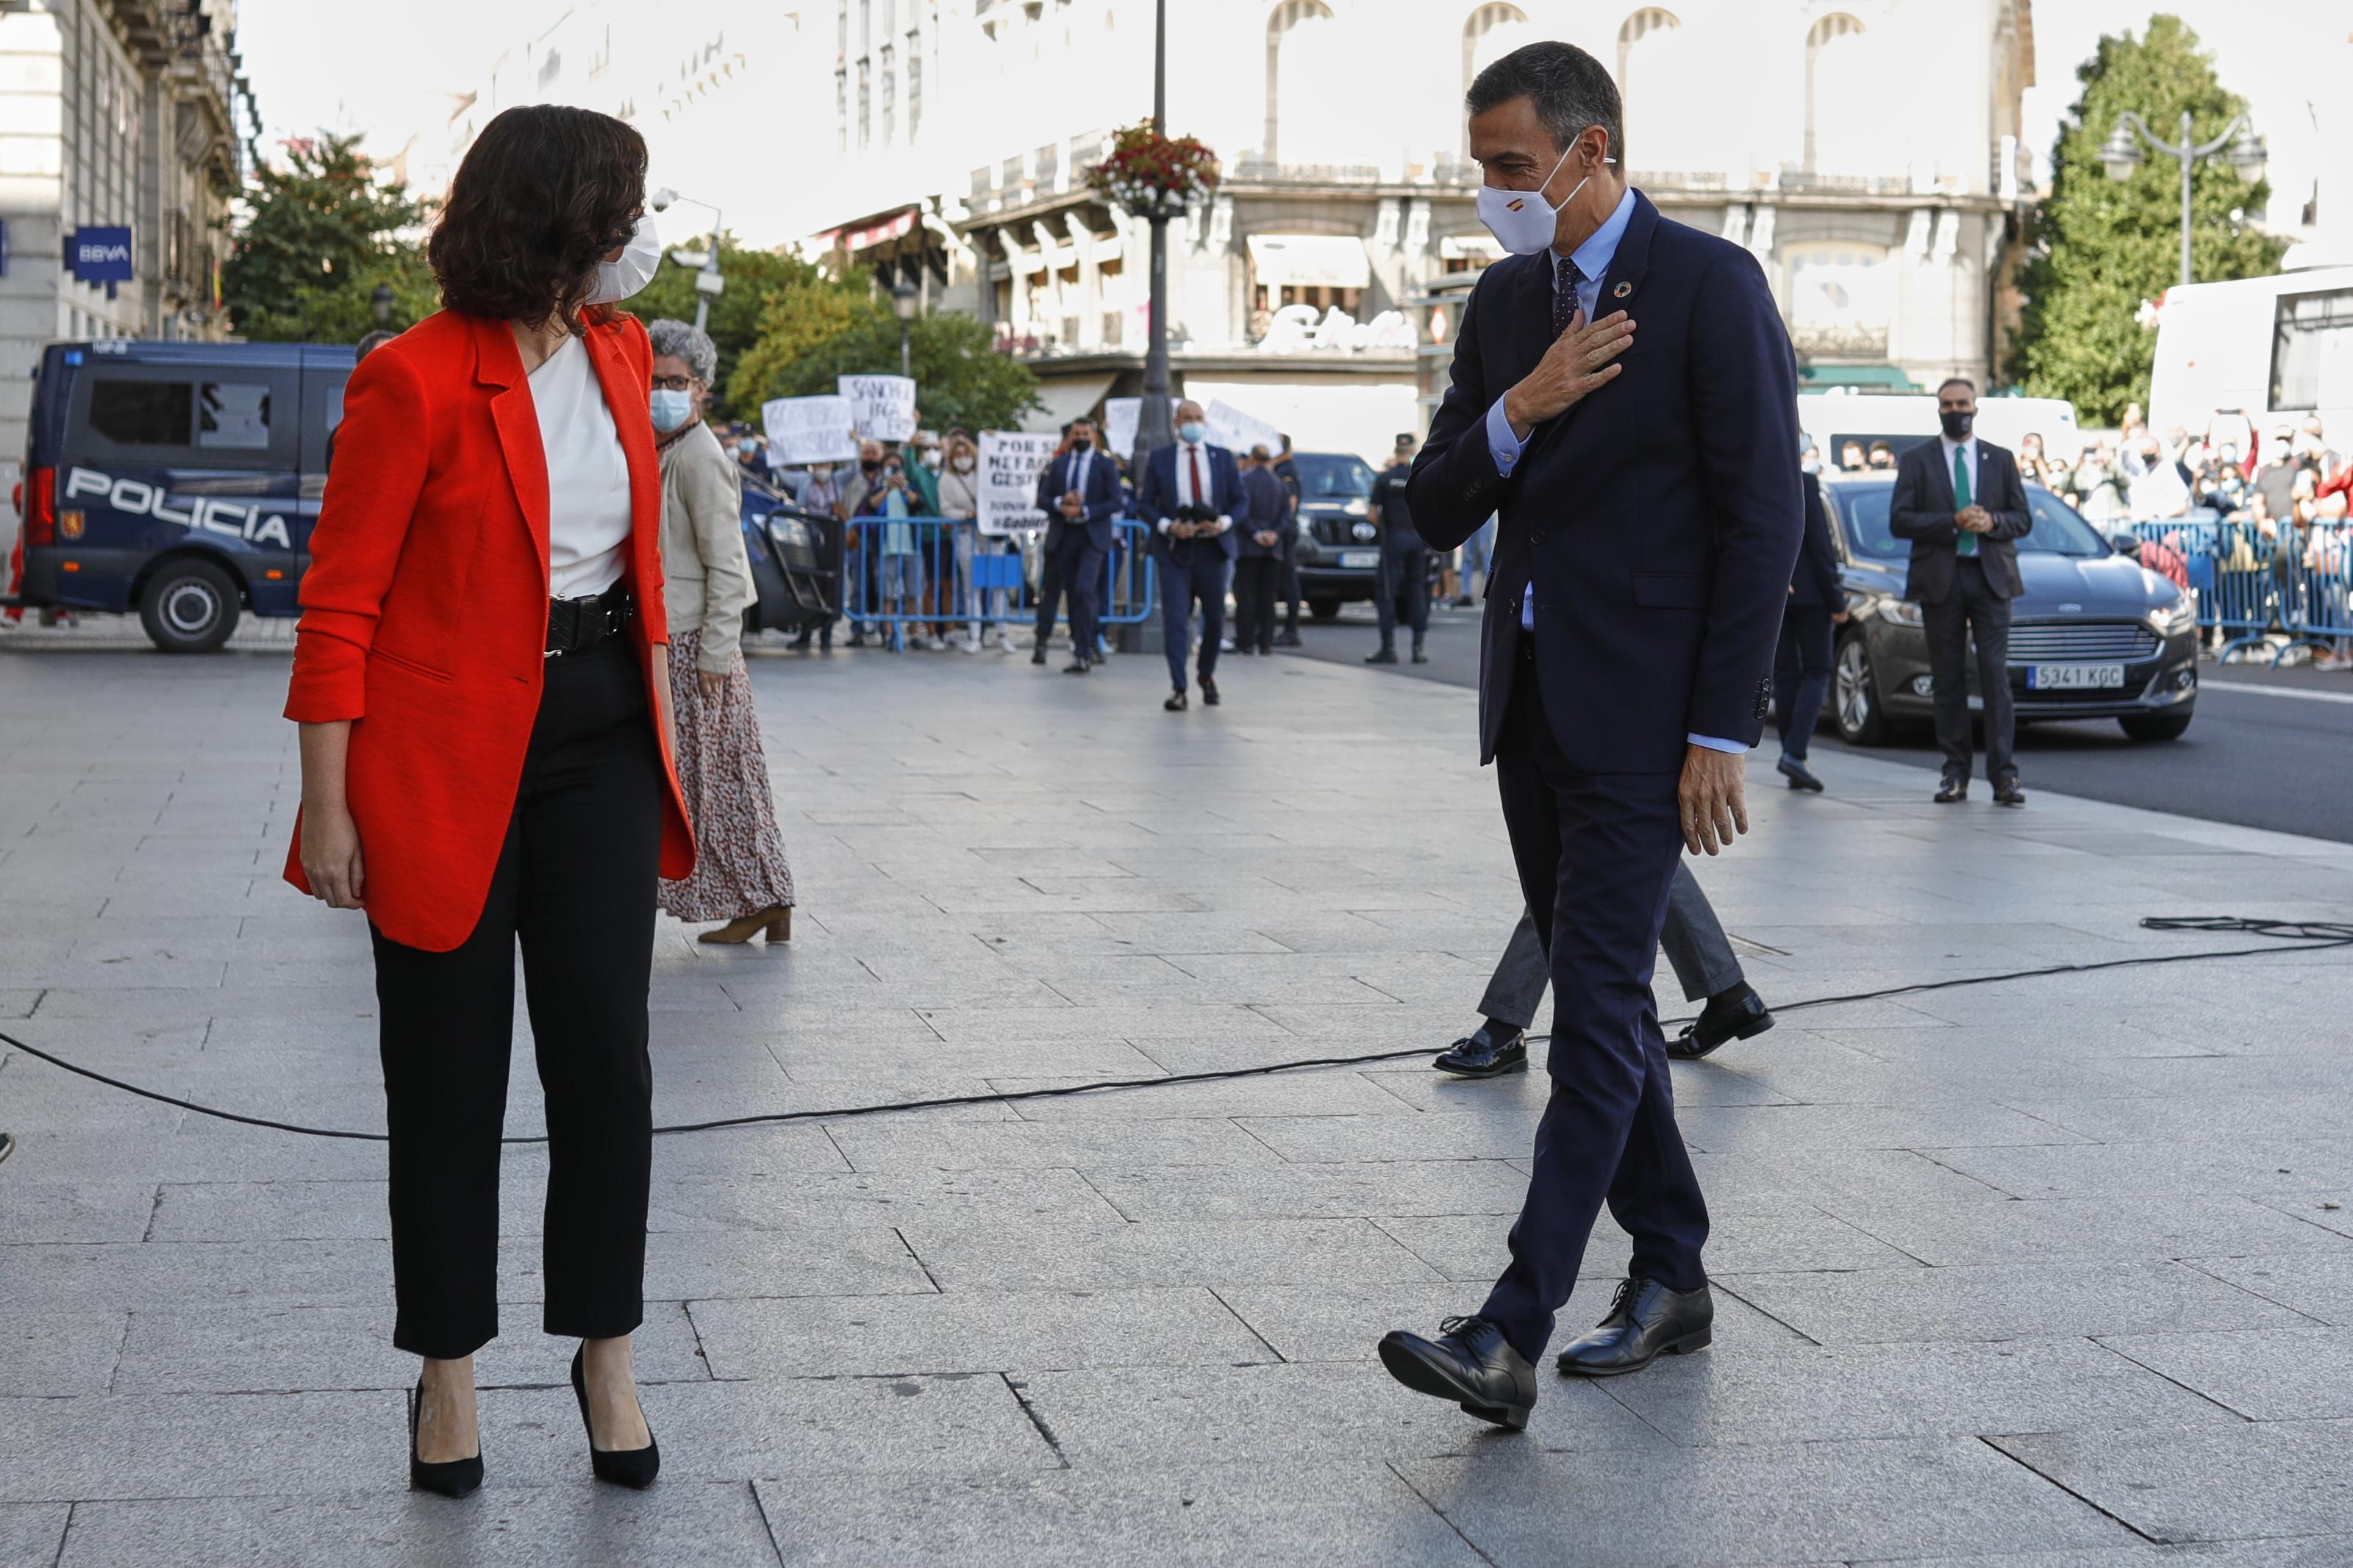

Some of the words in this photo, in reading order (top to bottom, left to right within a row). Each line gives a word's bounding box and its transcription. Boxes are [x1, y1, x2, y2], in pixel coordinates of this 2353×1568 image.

[79, 244, 129, 262] BBVA
[999, 440, 1035, 454] POR
[66, 466, 291, 549] POLICÍA
[2040, 667, 2081, 684] 5341
[2088, 667, 2120, 684] KGC
